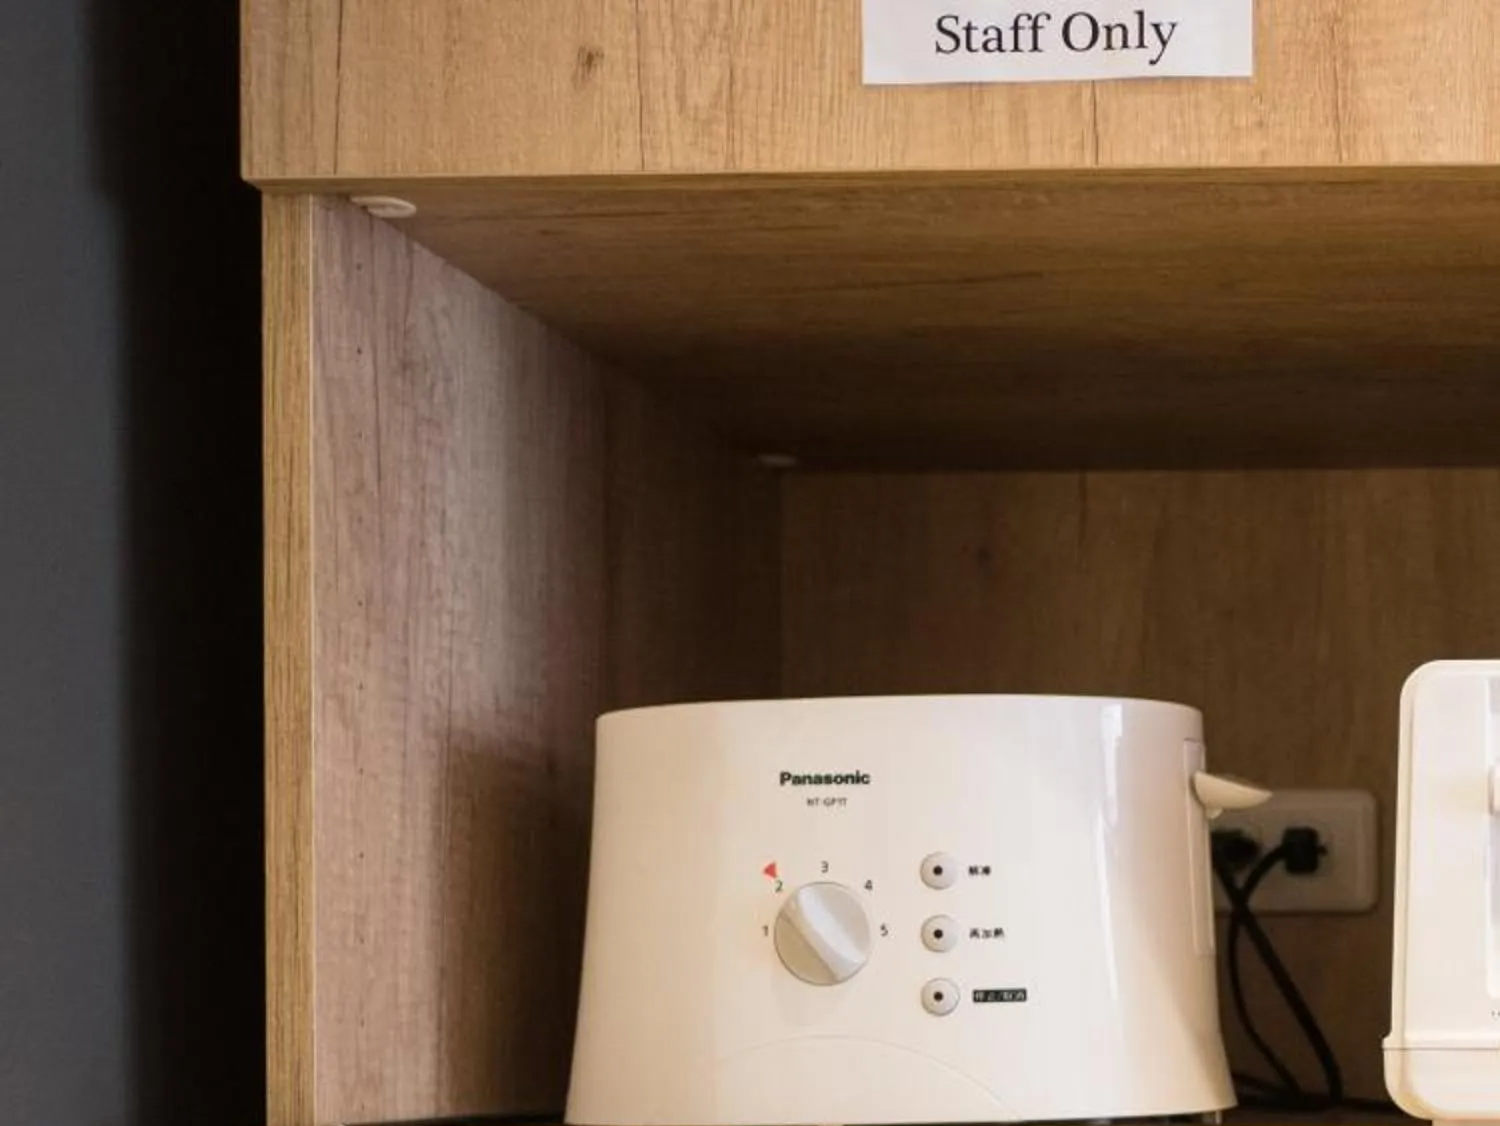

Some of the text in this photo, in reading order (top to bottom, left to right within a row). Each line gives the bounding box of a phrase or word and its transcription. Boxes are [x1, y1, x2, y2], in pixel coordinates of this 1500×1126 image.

[934, 10, 1178, 65] Staff Only
[780, 770, 871, 786] Panasonic
[821, 861, 829, 873] 3
[774, 880, 783, 892] 2
[864, 879, 873, 892] 4
[762, 925, 768, 937] 1
[881, 924, 888, 937] 5
